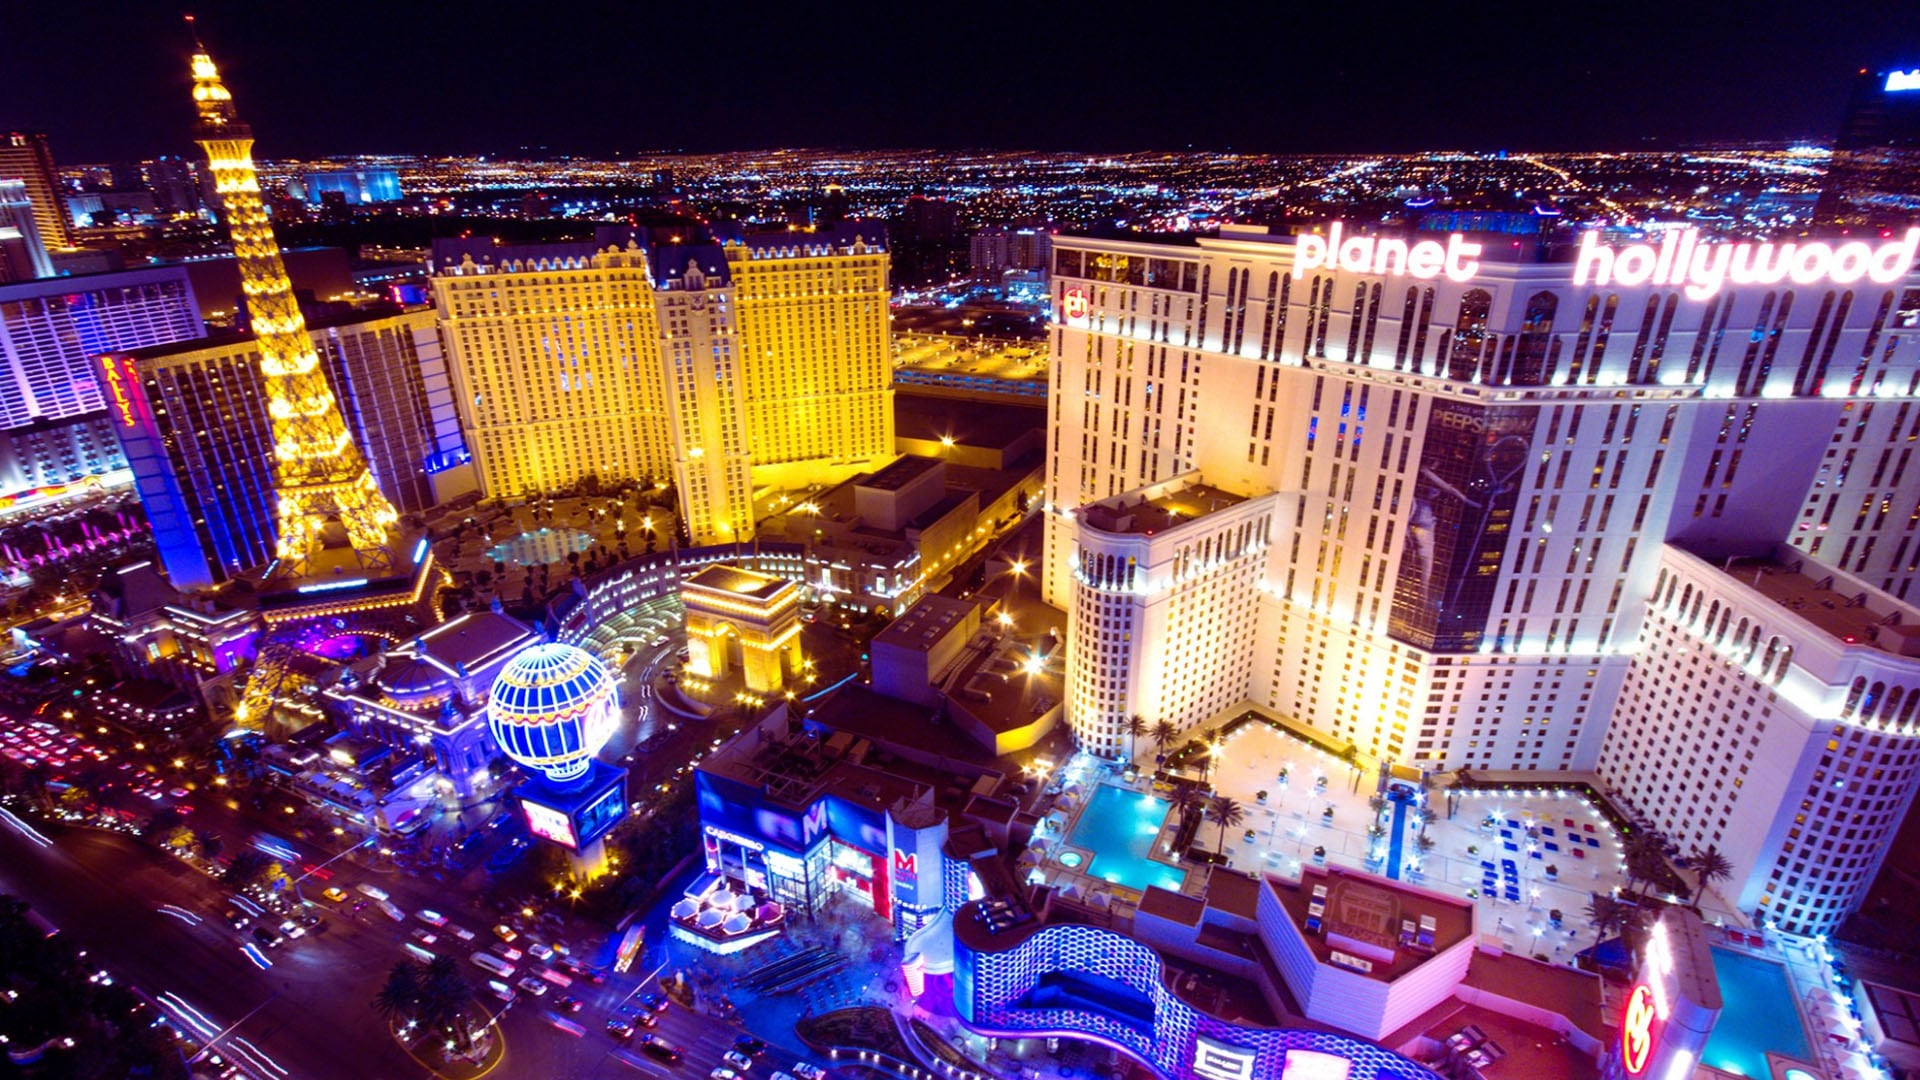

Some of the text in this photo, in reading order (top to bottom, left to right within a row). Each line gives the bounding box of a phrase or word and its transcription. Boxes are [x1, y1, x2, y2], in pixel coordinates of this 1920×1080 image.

[1292, 221, 1920, 301] planet hollywood
[802, 799, 828, 845] M
[894, 848, 918, 874] M
